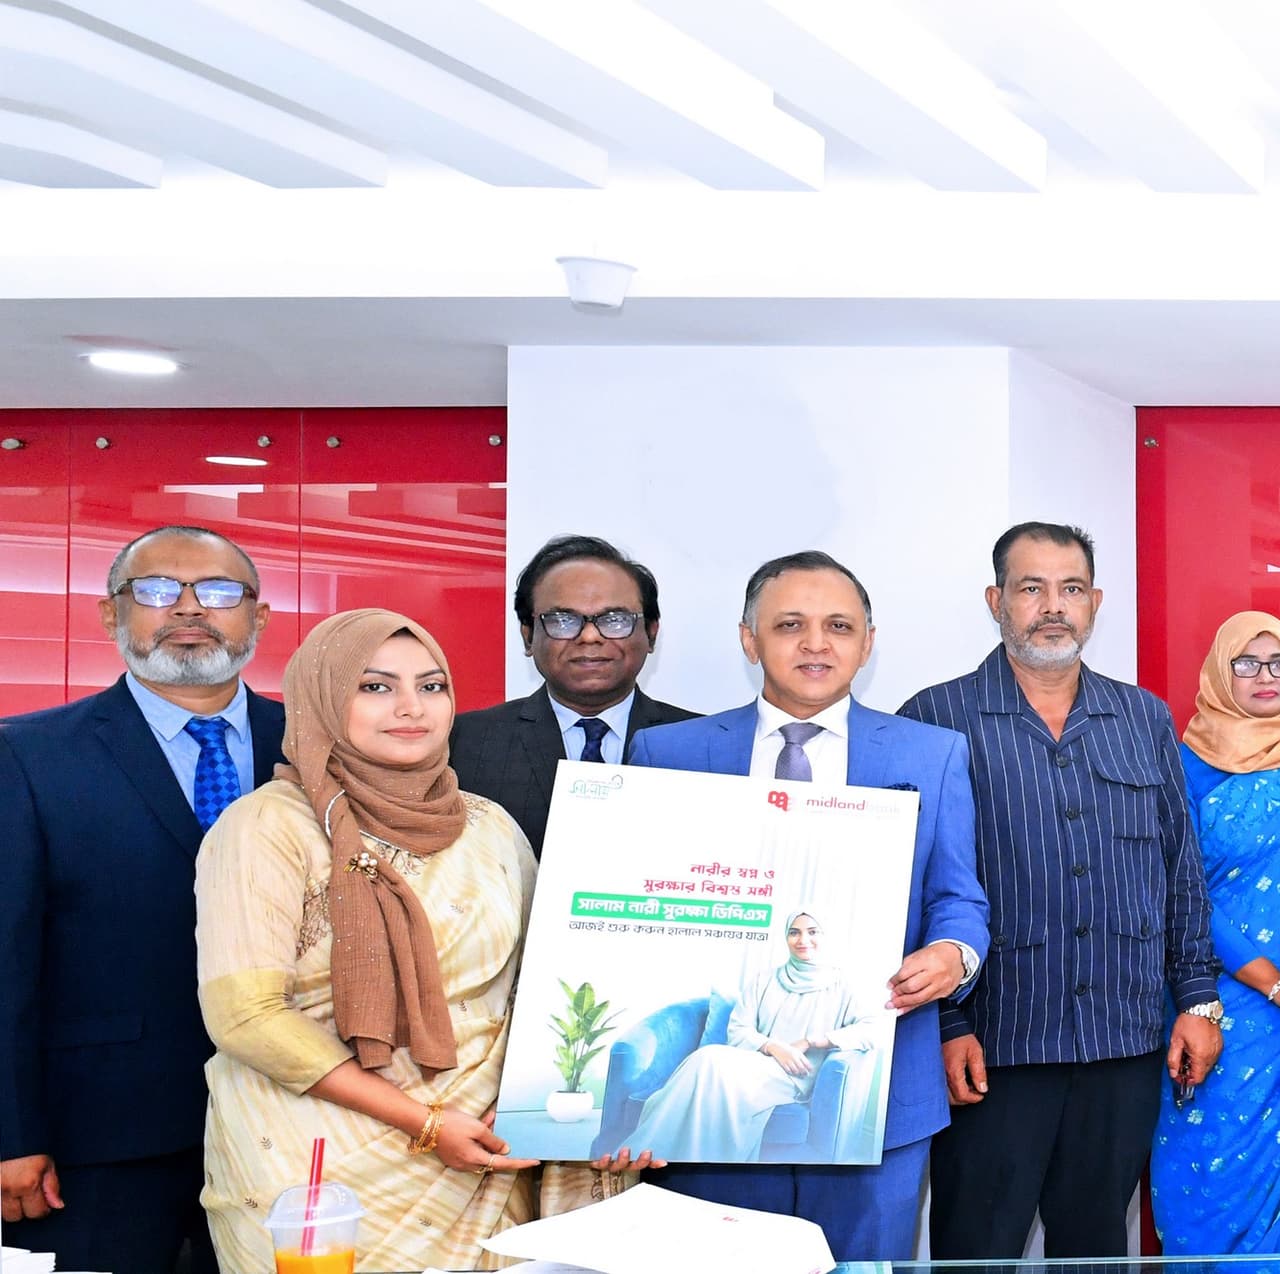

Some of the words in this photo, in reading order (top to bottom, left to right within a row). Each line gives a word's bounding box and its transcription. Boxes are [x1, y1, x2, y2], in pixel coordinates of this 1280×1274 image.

[690, 862, 731, 877] নারীর
[764, 870, 775, 879] ও
[643, 879, 695, 893] সুরক্ষার
[701, 880, 741, 895] বিশ্বস্ত
[747, 884, 773, 897] সঙ্গী
[577, 898, 624, 912] সালাম
[628, 899, 659, 915] নারী
[662, 903, 708, 920] সুরক্ষা
[712, 904, 768, 921] ডিপিএস
[569, 920, 605, 931] আজই
[633, 925, 664, 934] করুন
[667, 927, 701, 937] হালাল
[745, 931, 768, 941] যাত্রা
